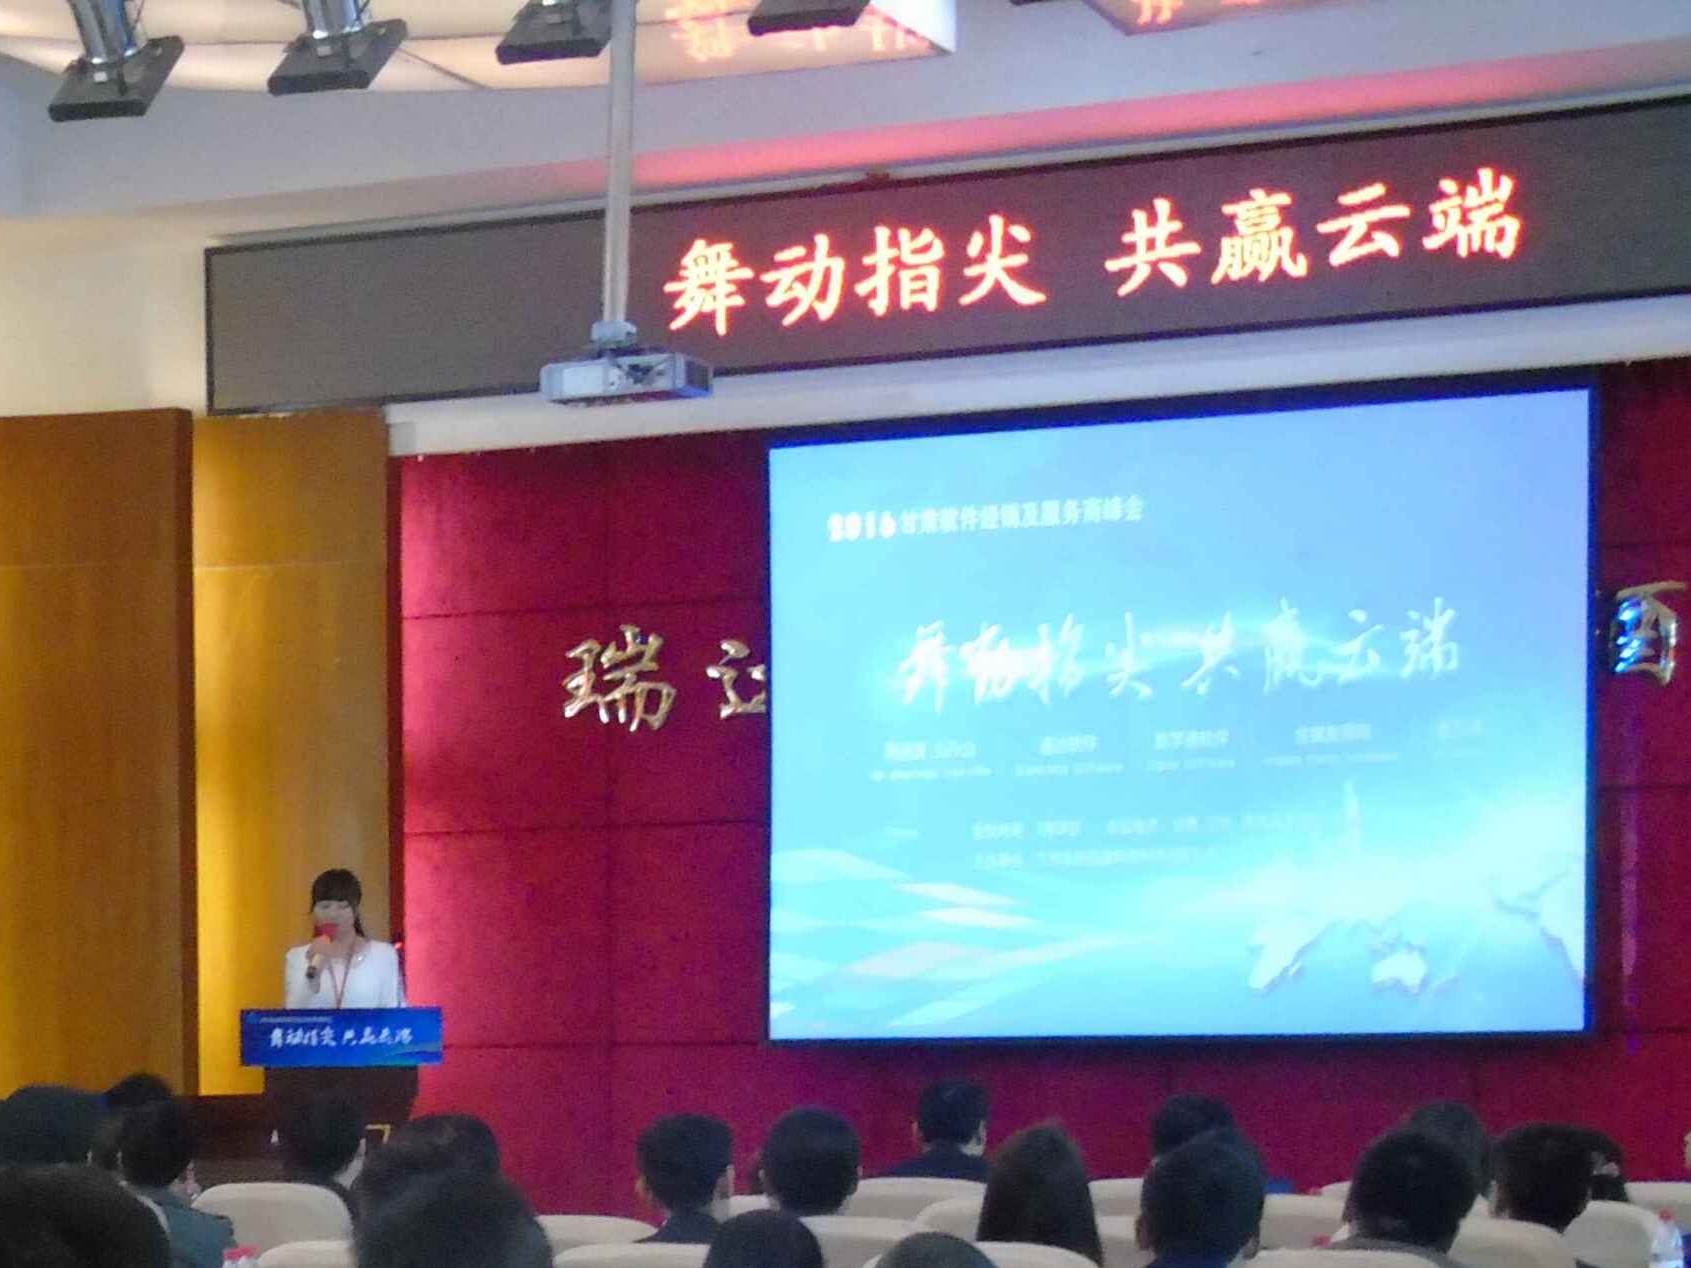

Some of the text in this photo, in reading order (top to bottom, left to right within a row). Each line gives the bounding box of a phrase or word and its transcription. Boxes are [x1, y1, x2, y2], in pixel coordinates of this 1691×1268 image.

[664, 168, 1524, 337] 舞动指尖 共赢云端
